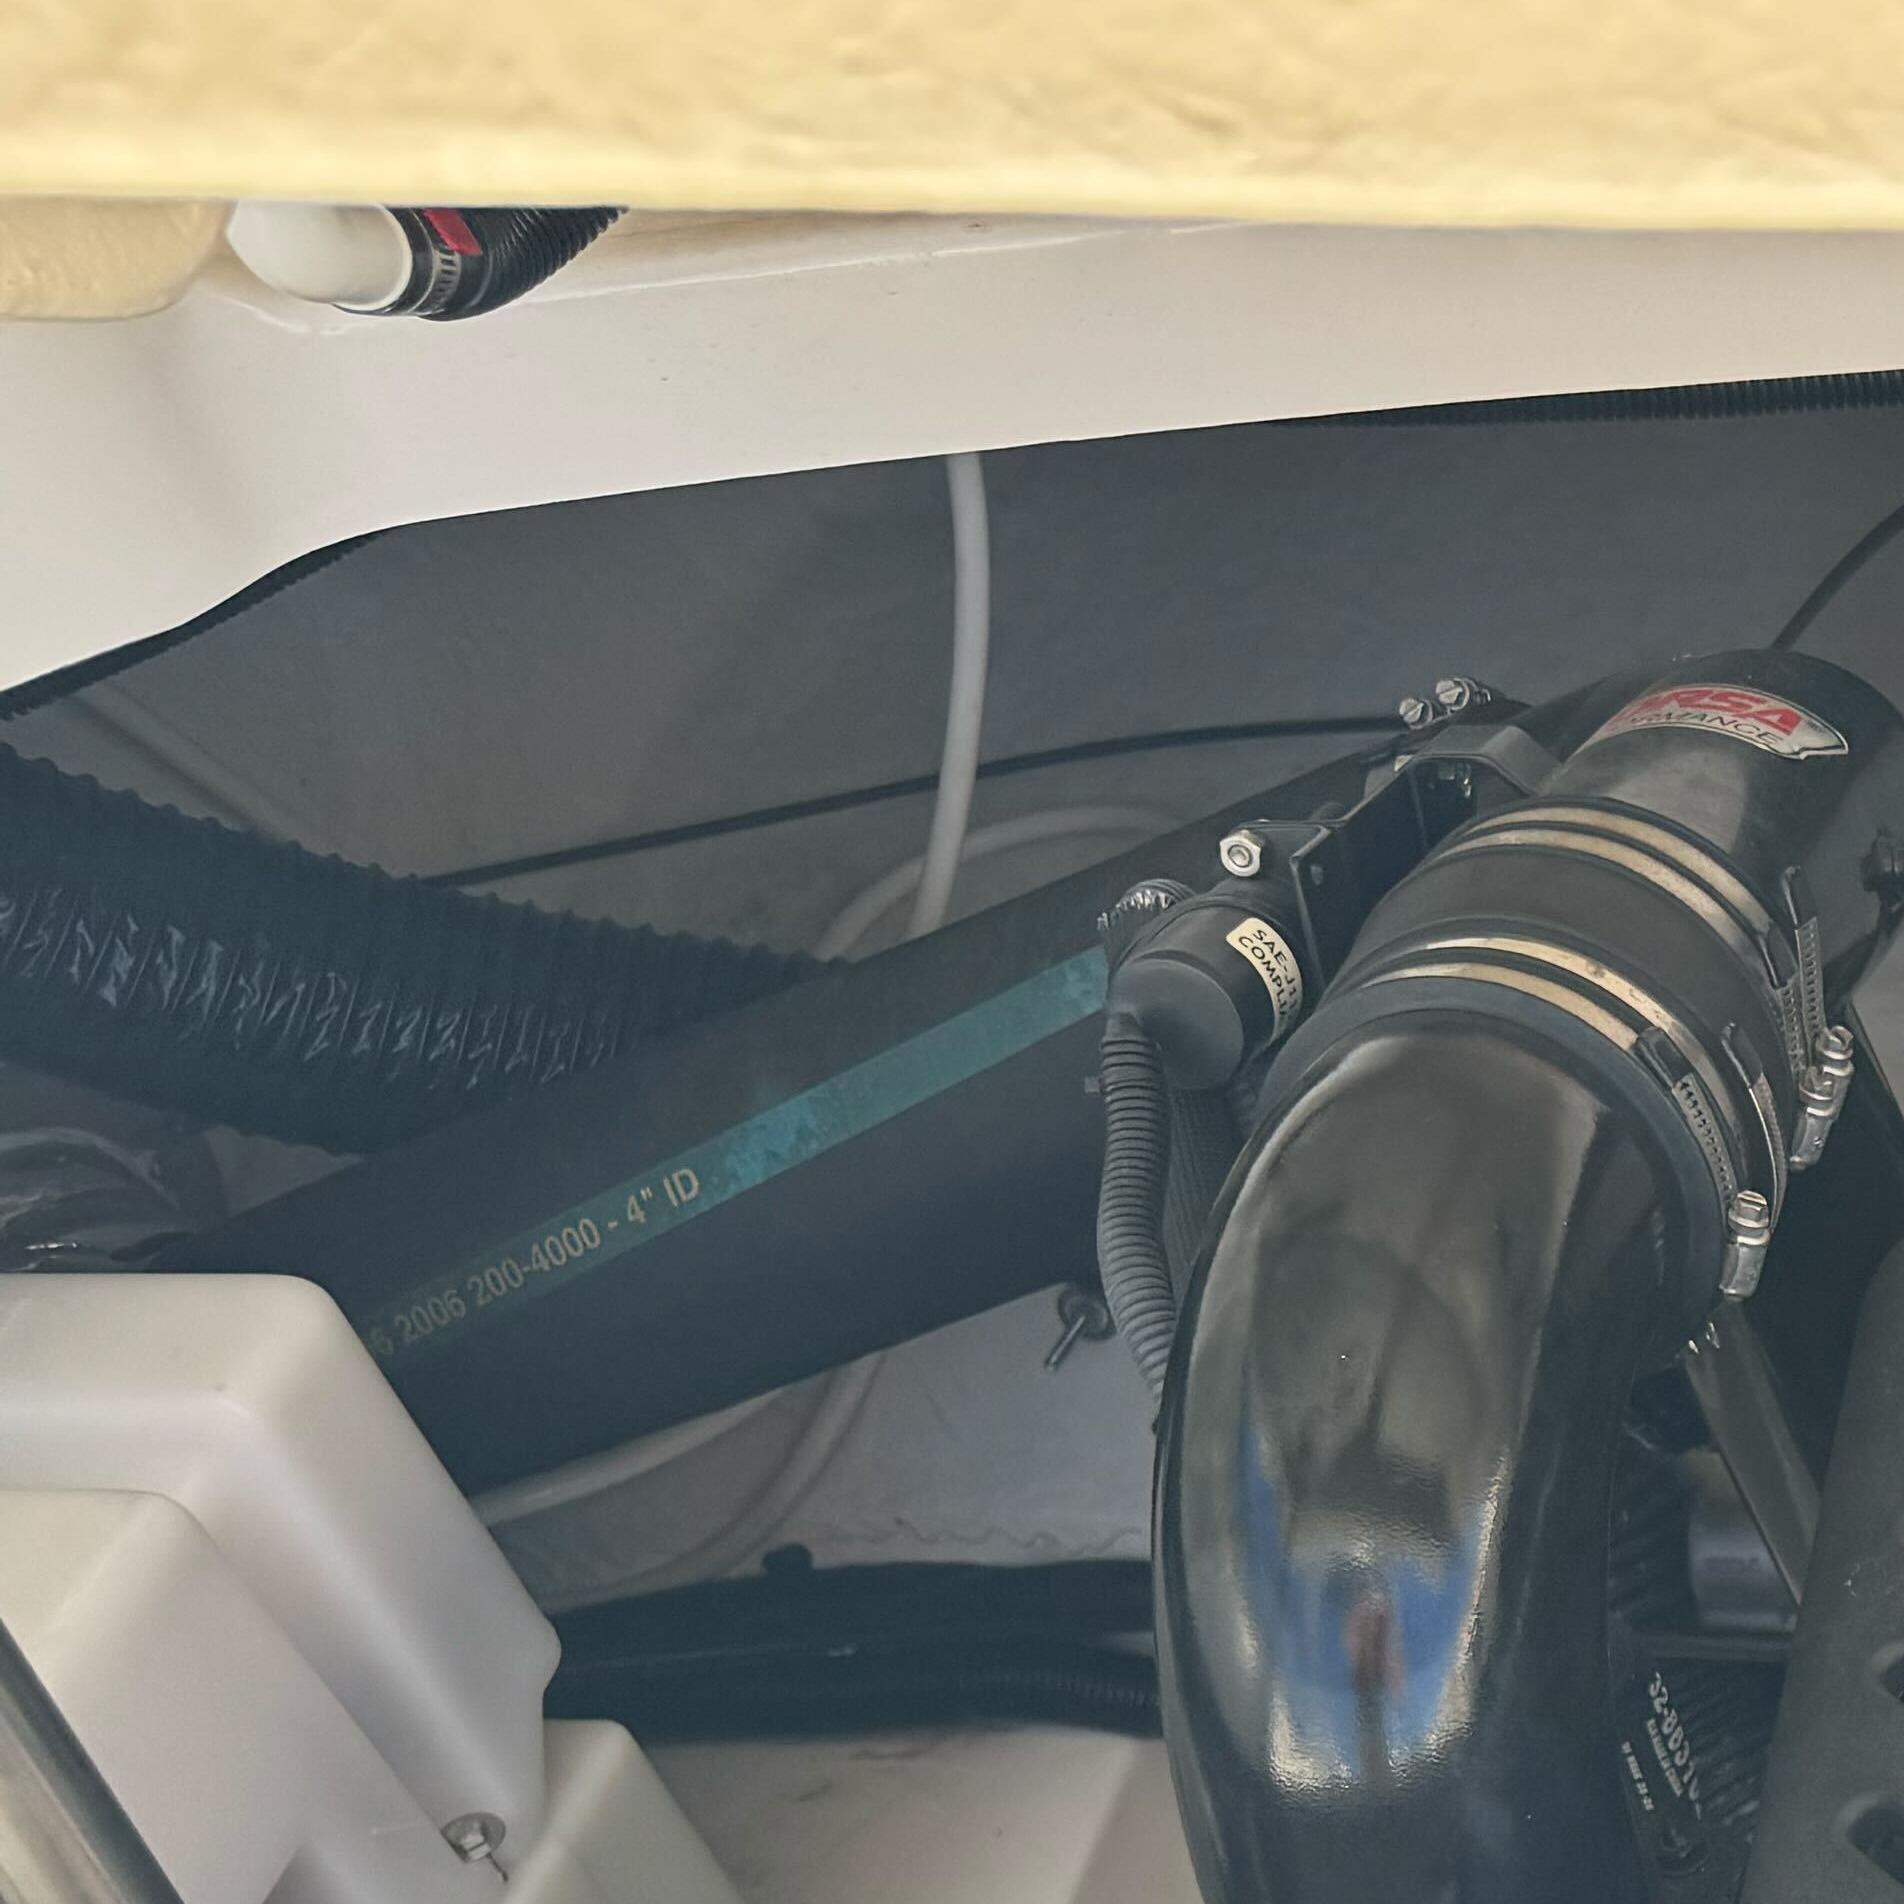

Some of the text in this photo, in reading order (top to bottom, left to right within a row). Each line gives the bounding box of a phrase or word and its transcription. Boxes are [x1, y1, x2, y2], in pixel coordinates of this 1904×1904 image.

[393, 1289, 467, 1343] 2006
[467, 1216, 601, 1308] 200-4000
[626, 1185, 654, 1225] 4"
[663, 1166, 701, 1209] ID
